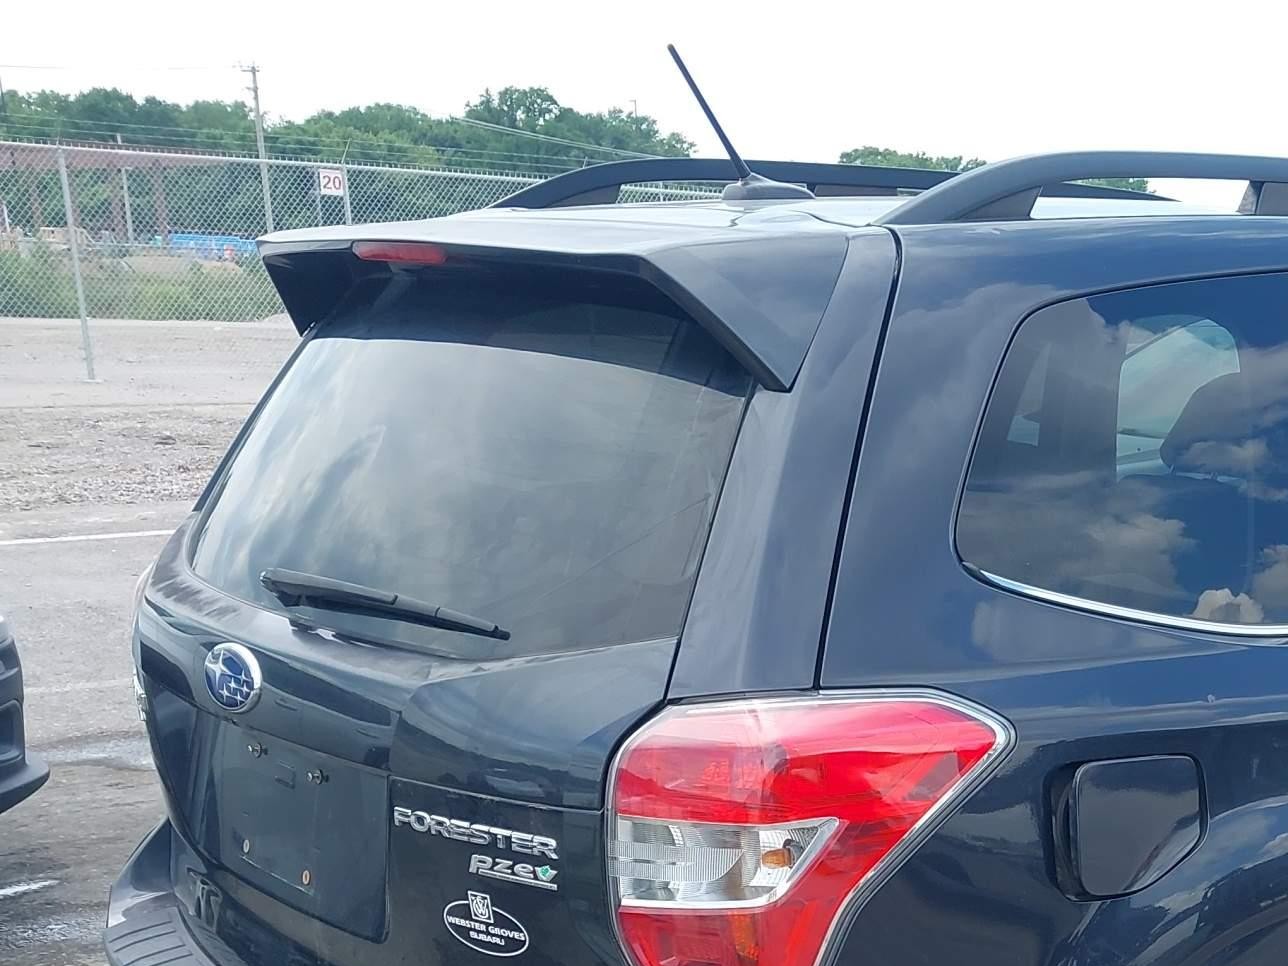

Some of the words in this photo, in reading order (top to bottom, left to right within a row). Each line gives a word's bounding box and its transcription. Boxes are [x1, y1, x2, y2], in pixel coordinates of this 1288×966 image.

[322, 174, 342, 190] 20
[393, 806, 559, 860] FORESTER
[446, 915, 487, 933] WEBSTER
[488, 925, 526, 942] GROVES
[469, 930, 506, 946] SUBARU
